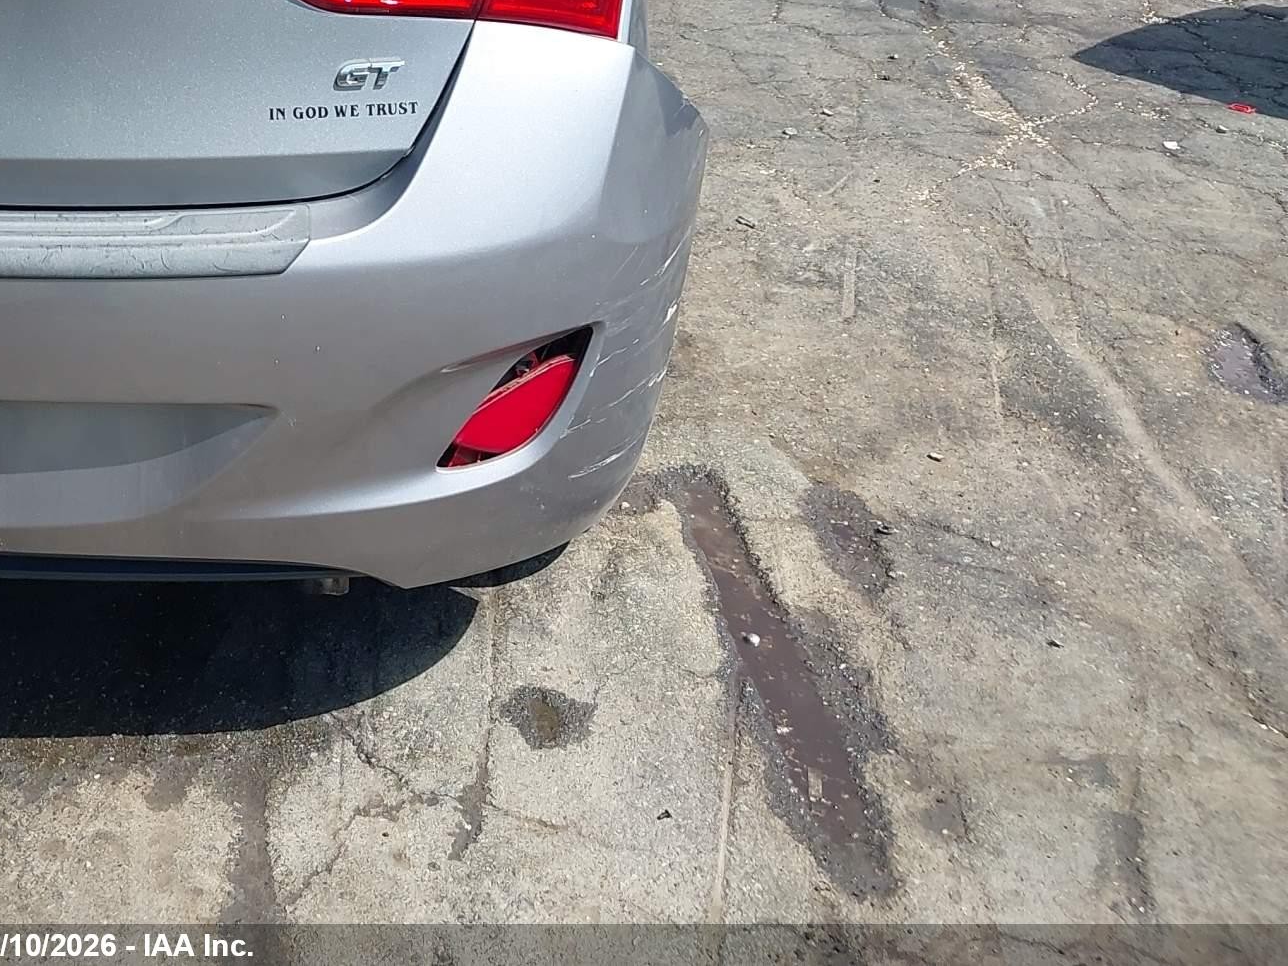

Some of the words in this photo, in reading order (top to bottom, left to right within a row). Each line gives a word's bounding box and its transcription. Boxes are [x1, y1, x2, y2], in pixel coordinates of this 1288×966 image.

[333, 57, 405, 91] GT
[269, 107, 286, 121] IN
[293, 106, 329, 120] GOD
[334, 104, 360, 118] WE
[366, 101, 419, 116] TRUST
